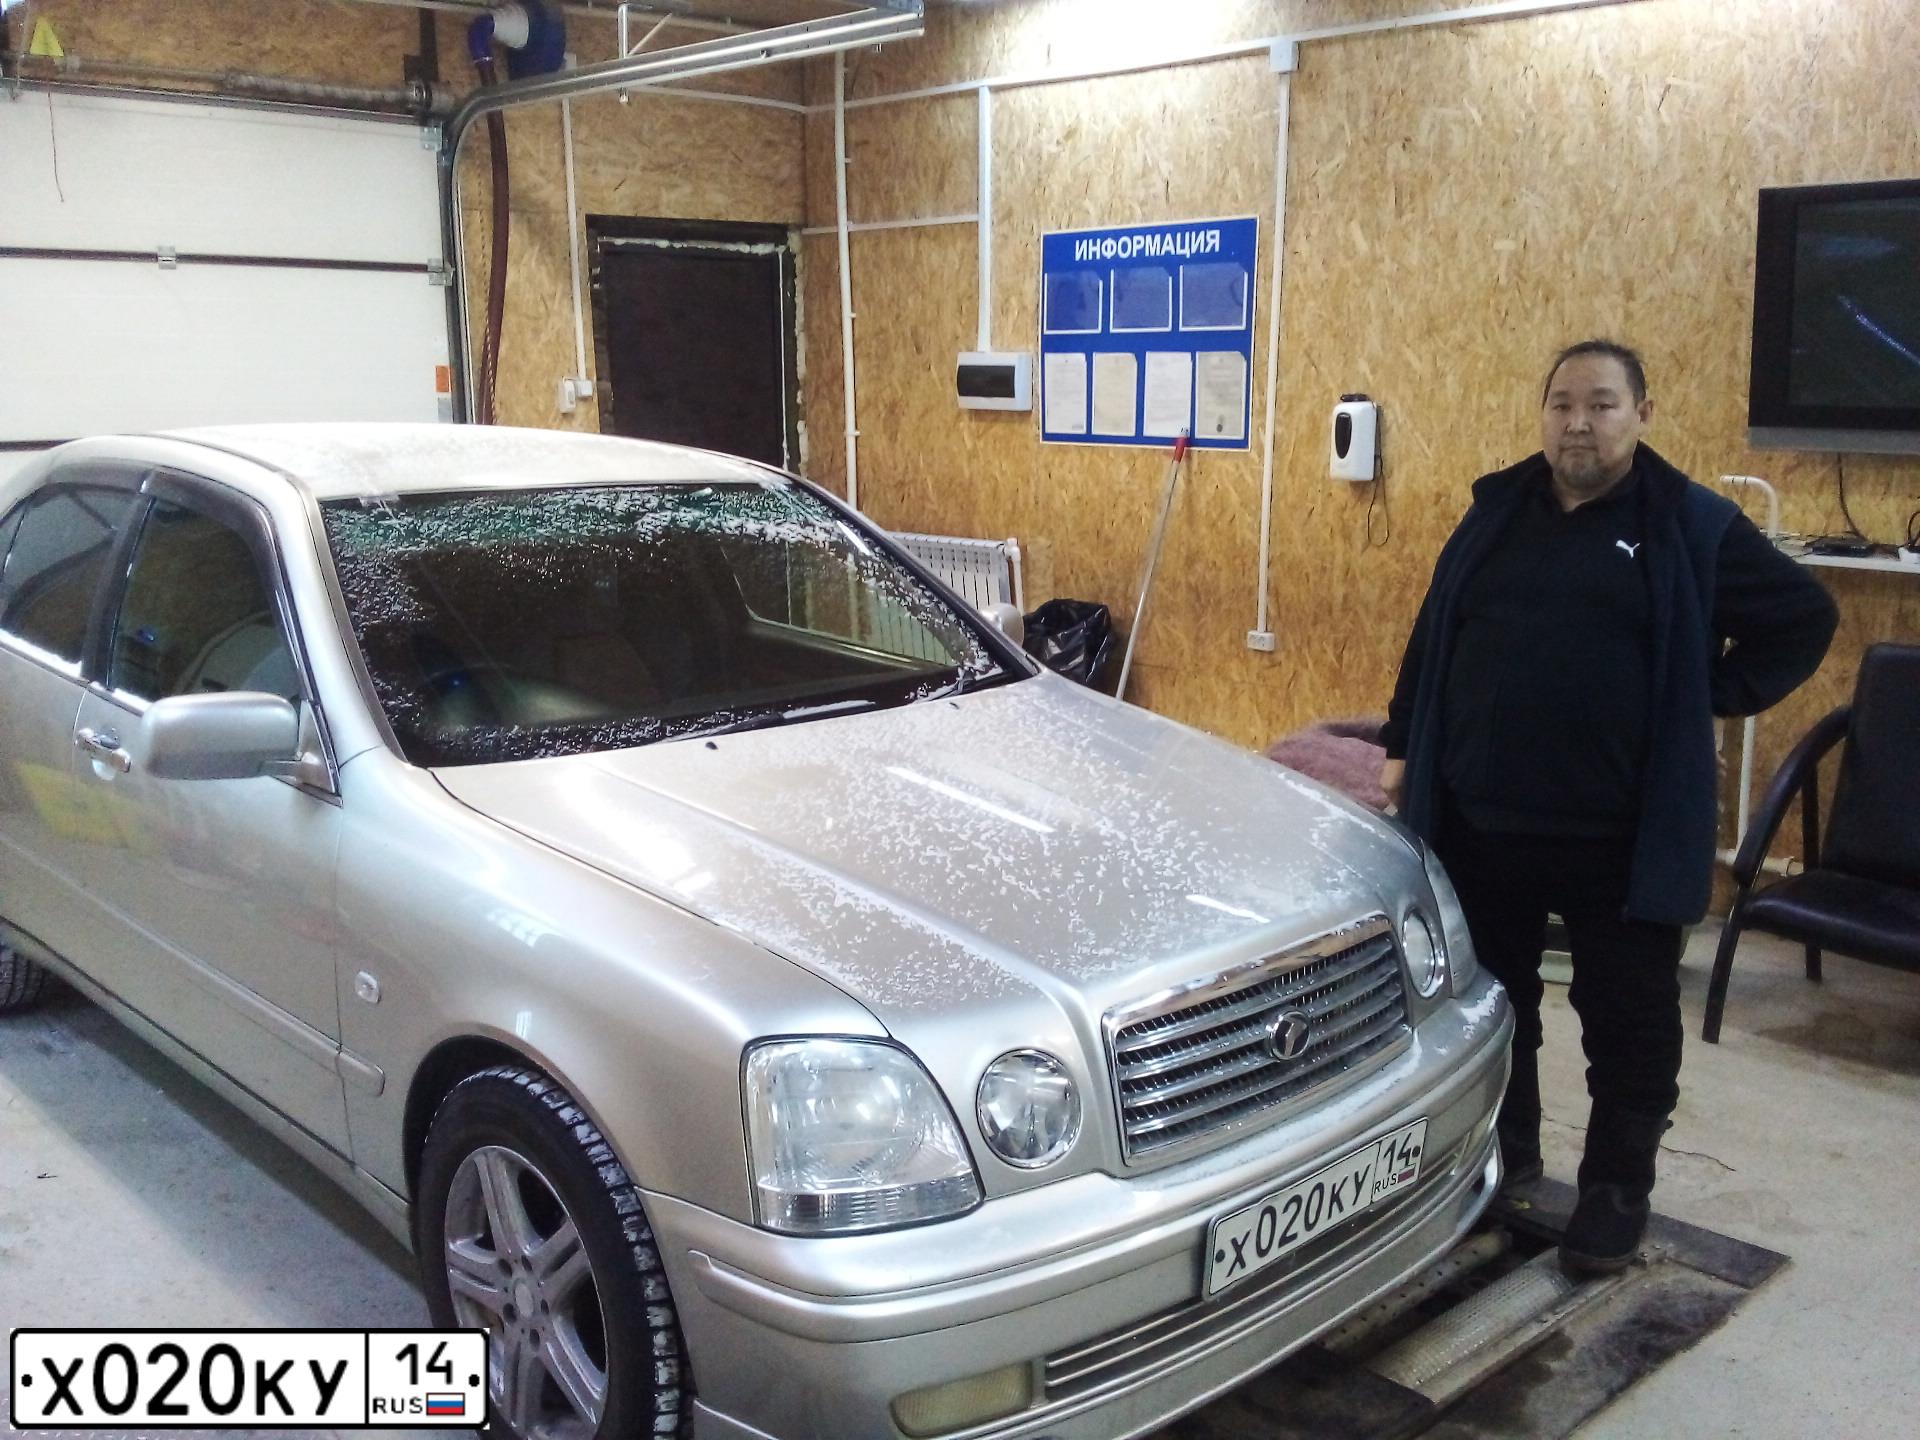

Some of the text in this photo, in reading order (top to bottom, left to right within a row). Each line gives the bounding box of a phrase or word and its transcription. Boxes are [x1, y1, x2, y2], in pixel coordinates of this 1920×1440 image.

[1075, 229, 1221, 262] ИНФОРМАЦИЯ
[1383, 1132, 1413, 1174] 14
[1373, 1173, 1398, 1193] RUS
